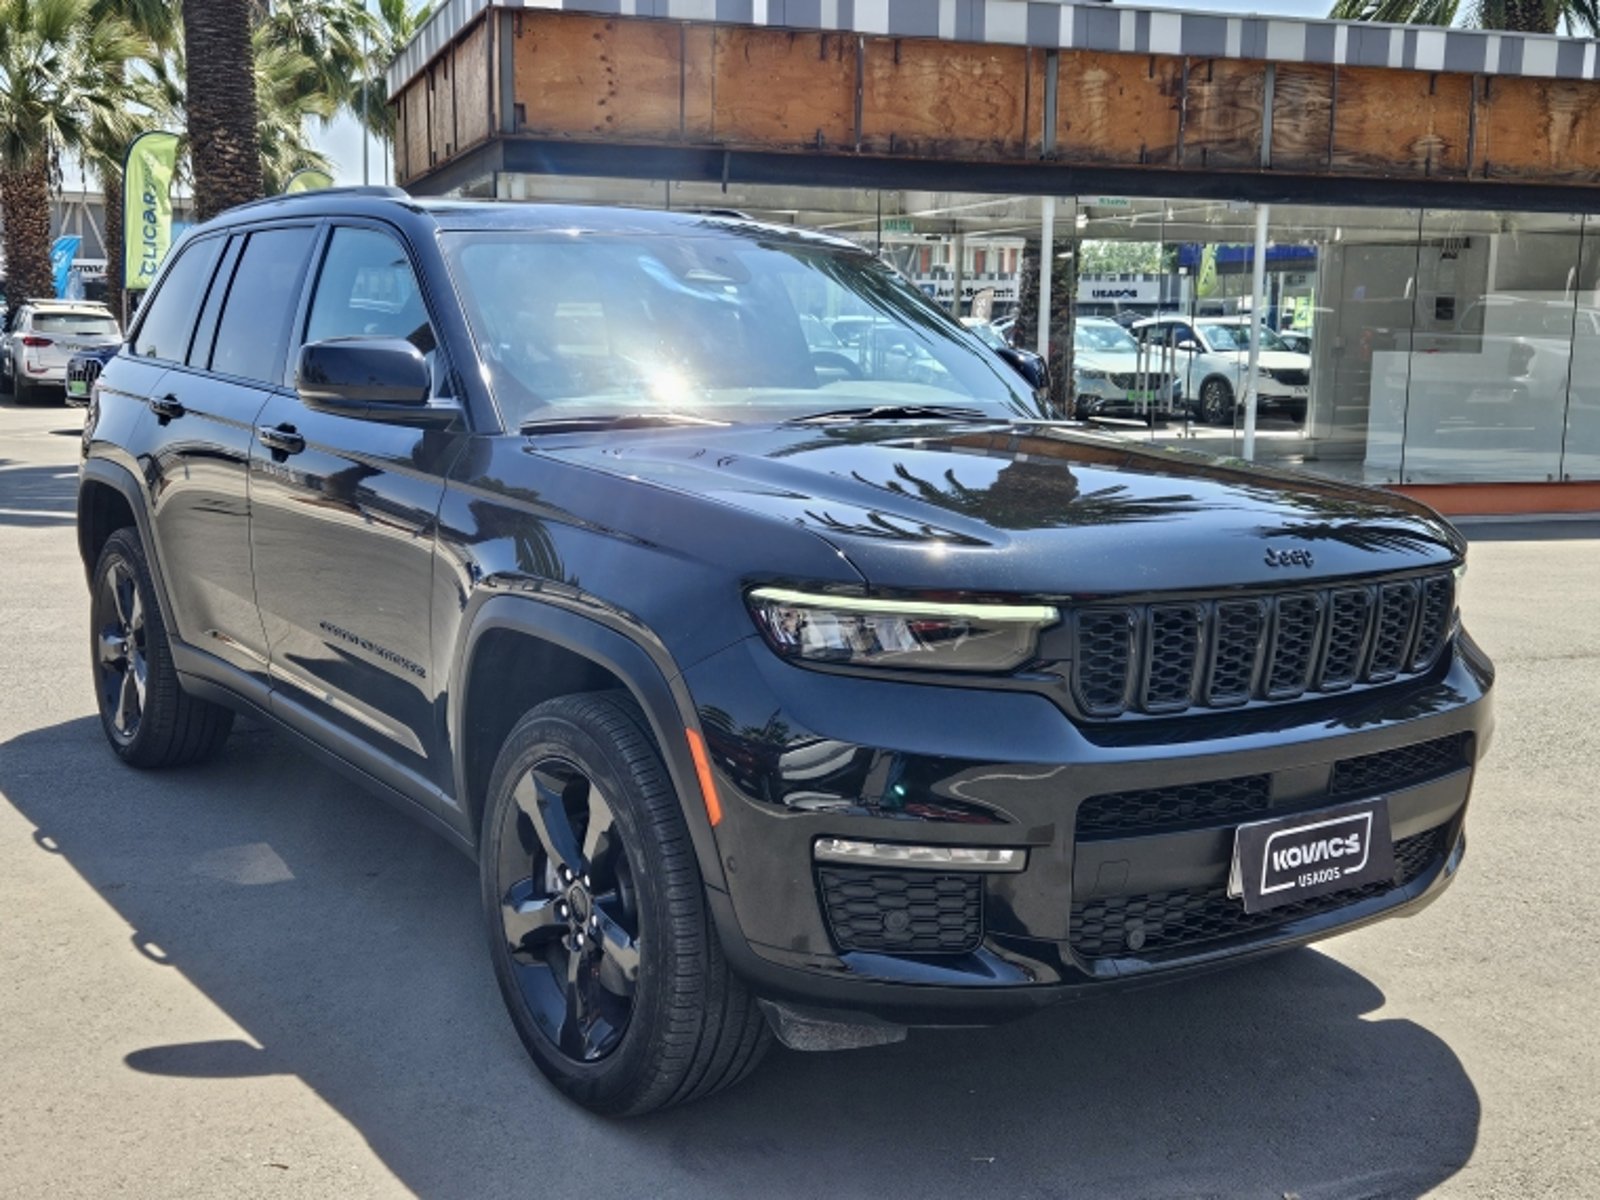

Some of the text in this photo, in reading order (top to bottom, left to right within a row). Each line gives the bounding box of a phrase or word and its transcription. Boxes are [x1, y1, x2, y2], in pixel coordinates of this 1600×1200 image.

[1264, 547, 1314, 569] Jeep
[1272, 833, 1361, 872] KOVACS
[1298, 866, 1341, 888] USADOS
